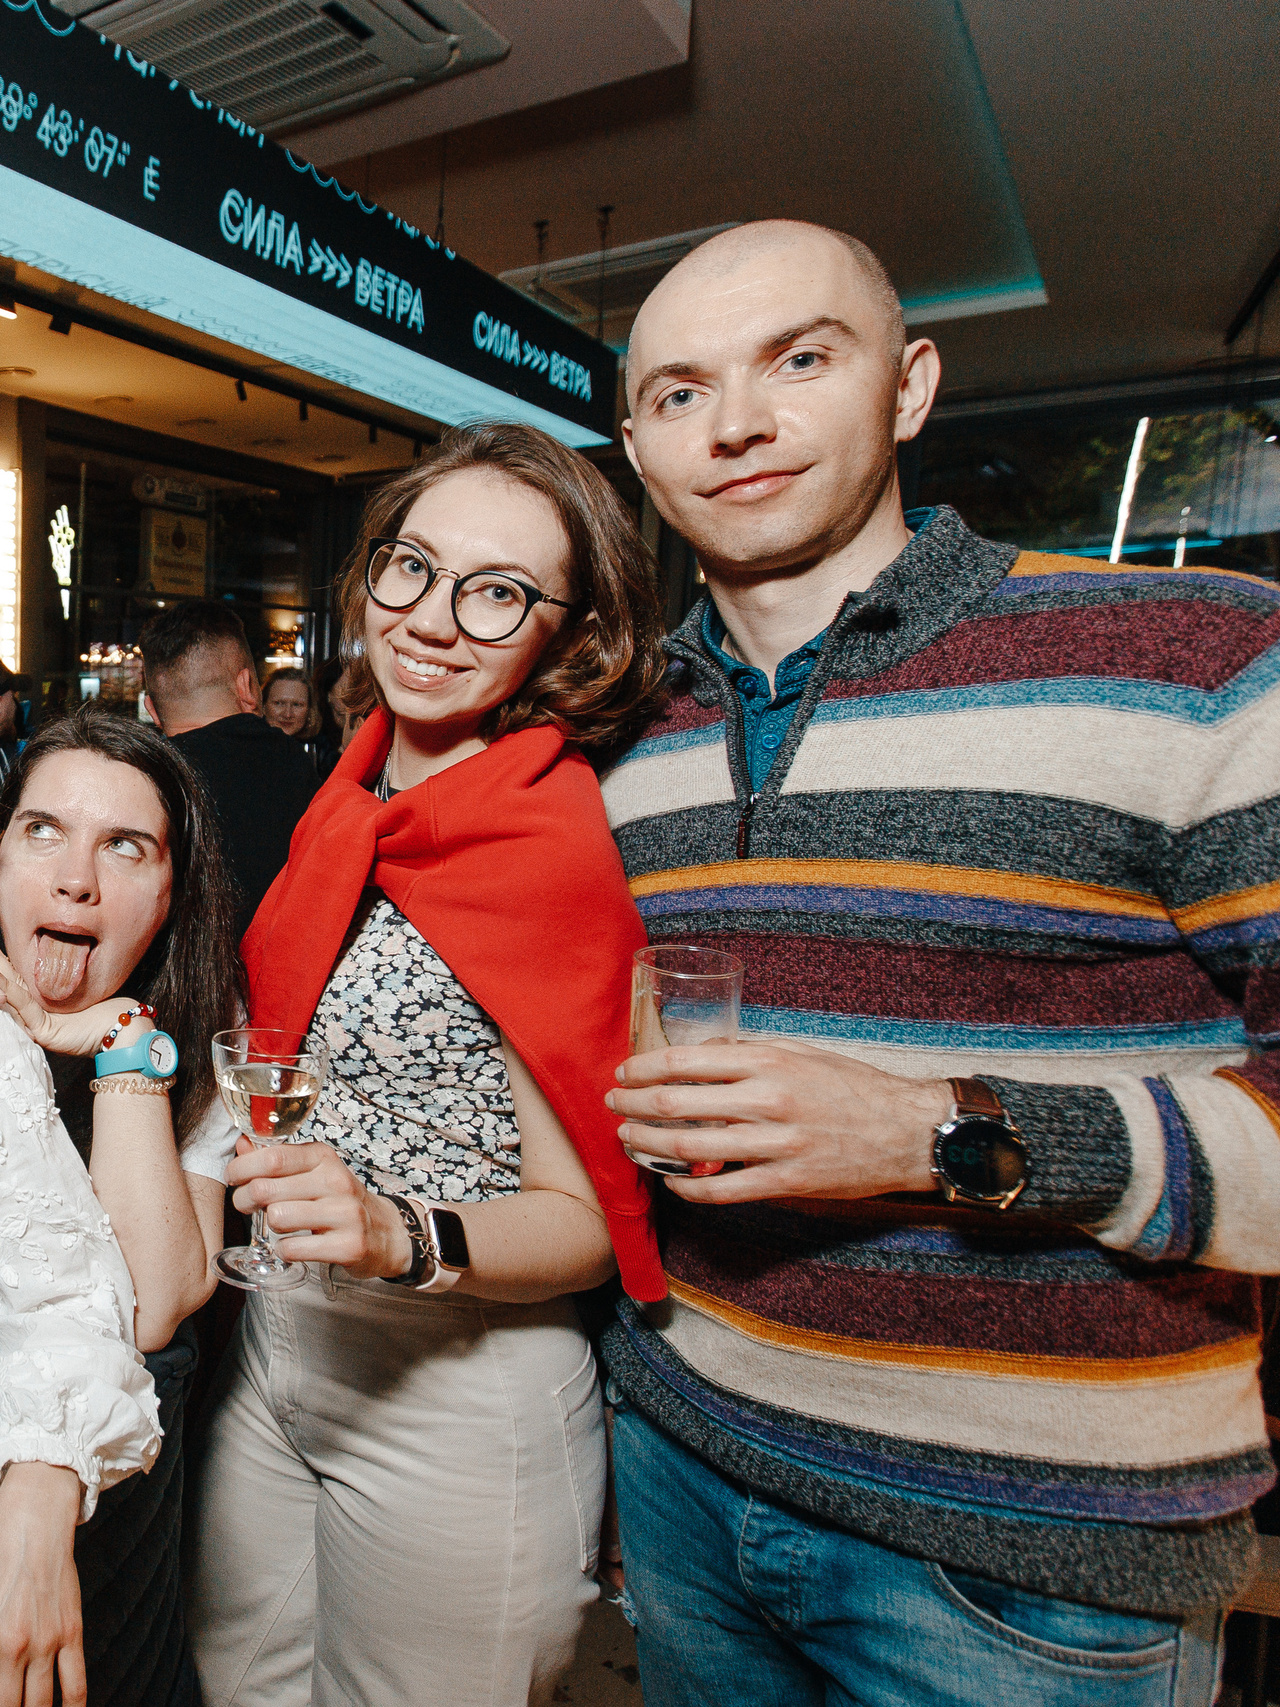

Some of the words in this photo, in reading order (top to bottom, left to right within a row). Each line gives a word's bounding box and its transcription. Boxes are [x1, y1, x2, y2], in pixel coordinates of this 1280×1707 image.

[142, 154, 161, 203] E
[218, 187, 305, 276] СИЛА
[353, 256, 426, 335] ВЕТРА
[472, 310, 522, 369] СИЛА
[548, 349, 593, 404] ВЕТРА
